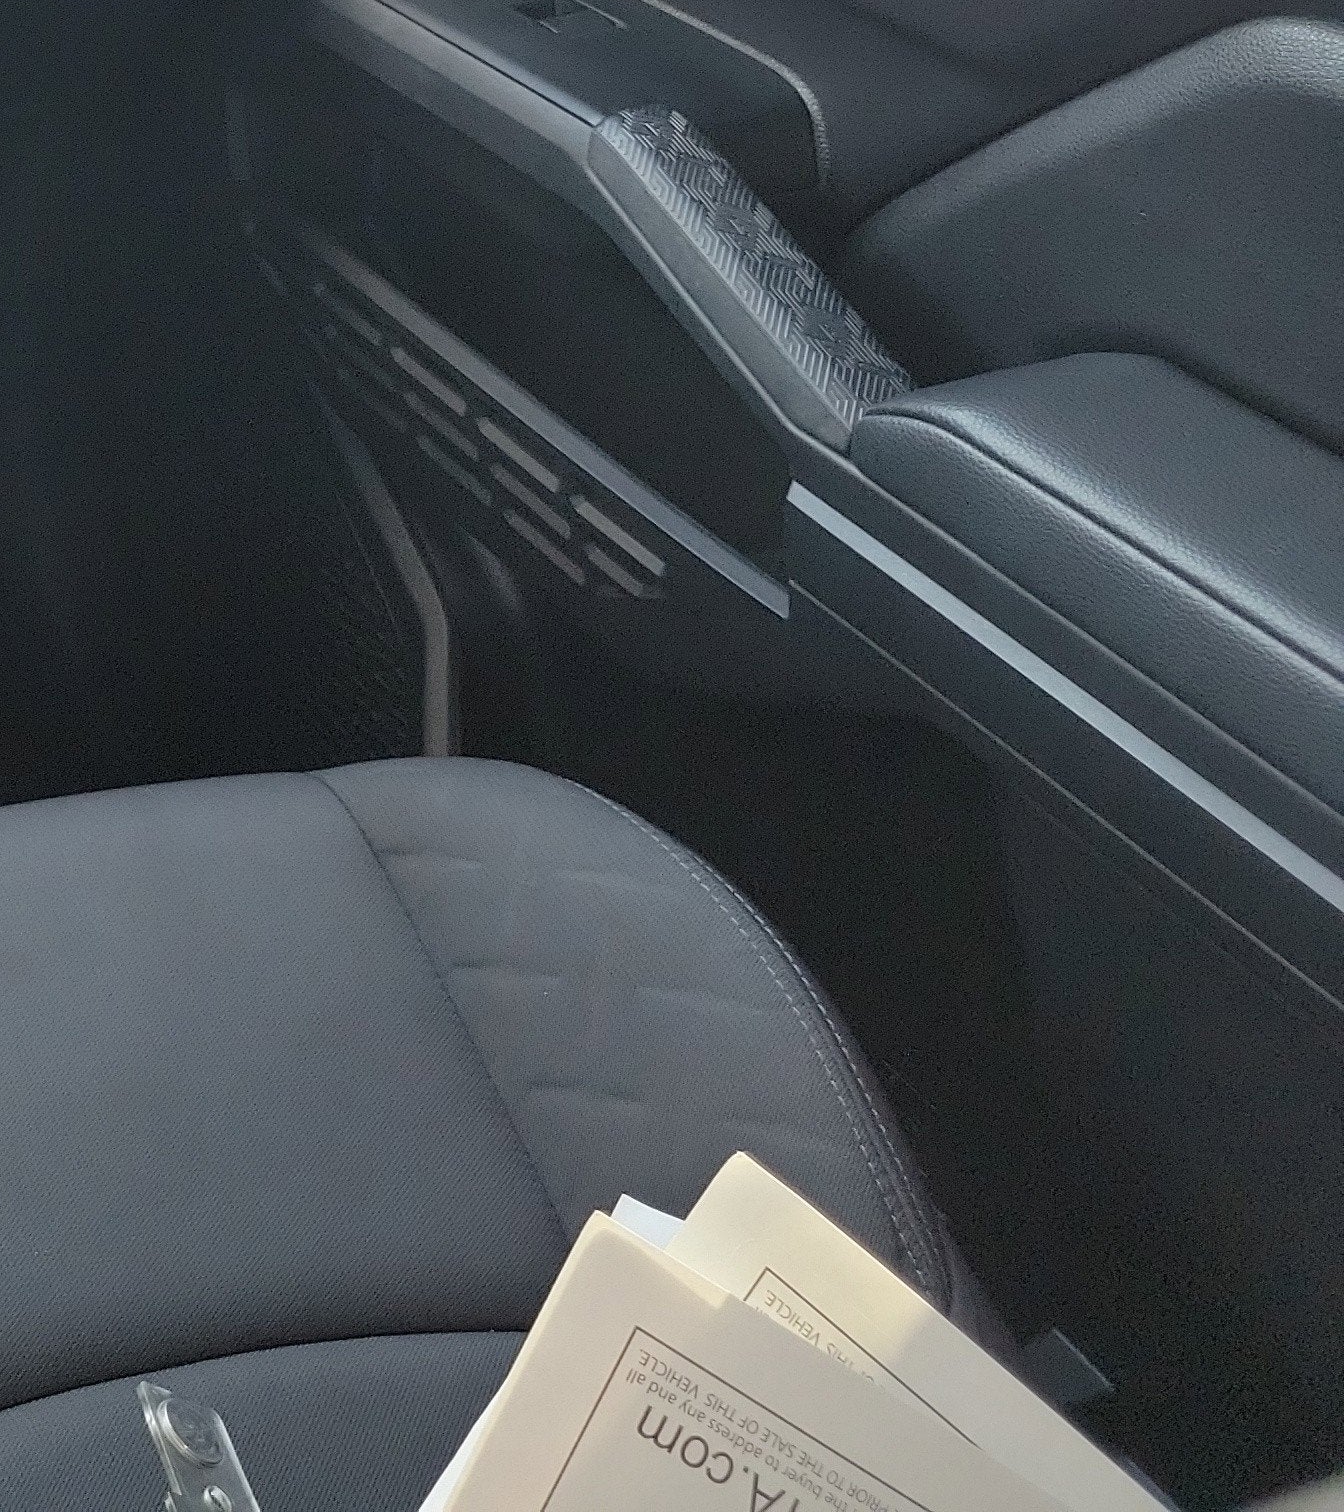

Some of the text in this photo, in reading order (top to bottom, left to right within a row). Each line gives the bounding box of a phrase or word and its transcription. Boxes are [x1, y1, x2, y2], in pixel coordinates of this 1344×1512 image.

[625, 1368, 646, 1384] all
[638, 1349, 699, 1399] VEHICLE.
[645, 1381, 678, 1404] and
[679, 1399, 707, 1422] any
[704, 1393, 736, 1423] THIS
[707, 1418, 763, 1459] address
[737, 1417, 760, 1435] OF
[760, 1427, 797, 1459] SALE
[636, 1405, 800, 1512] A.com
[764, 1454, 780, 1472] to
[796, 1450, 825, 1478] THE
[781, 1465, 823, 1500] buyer
[826, 1470, 845, 1491] TO
